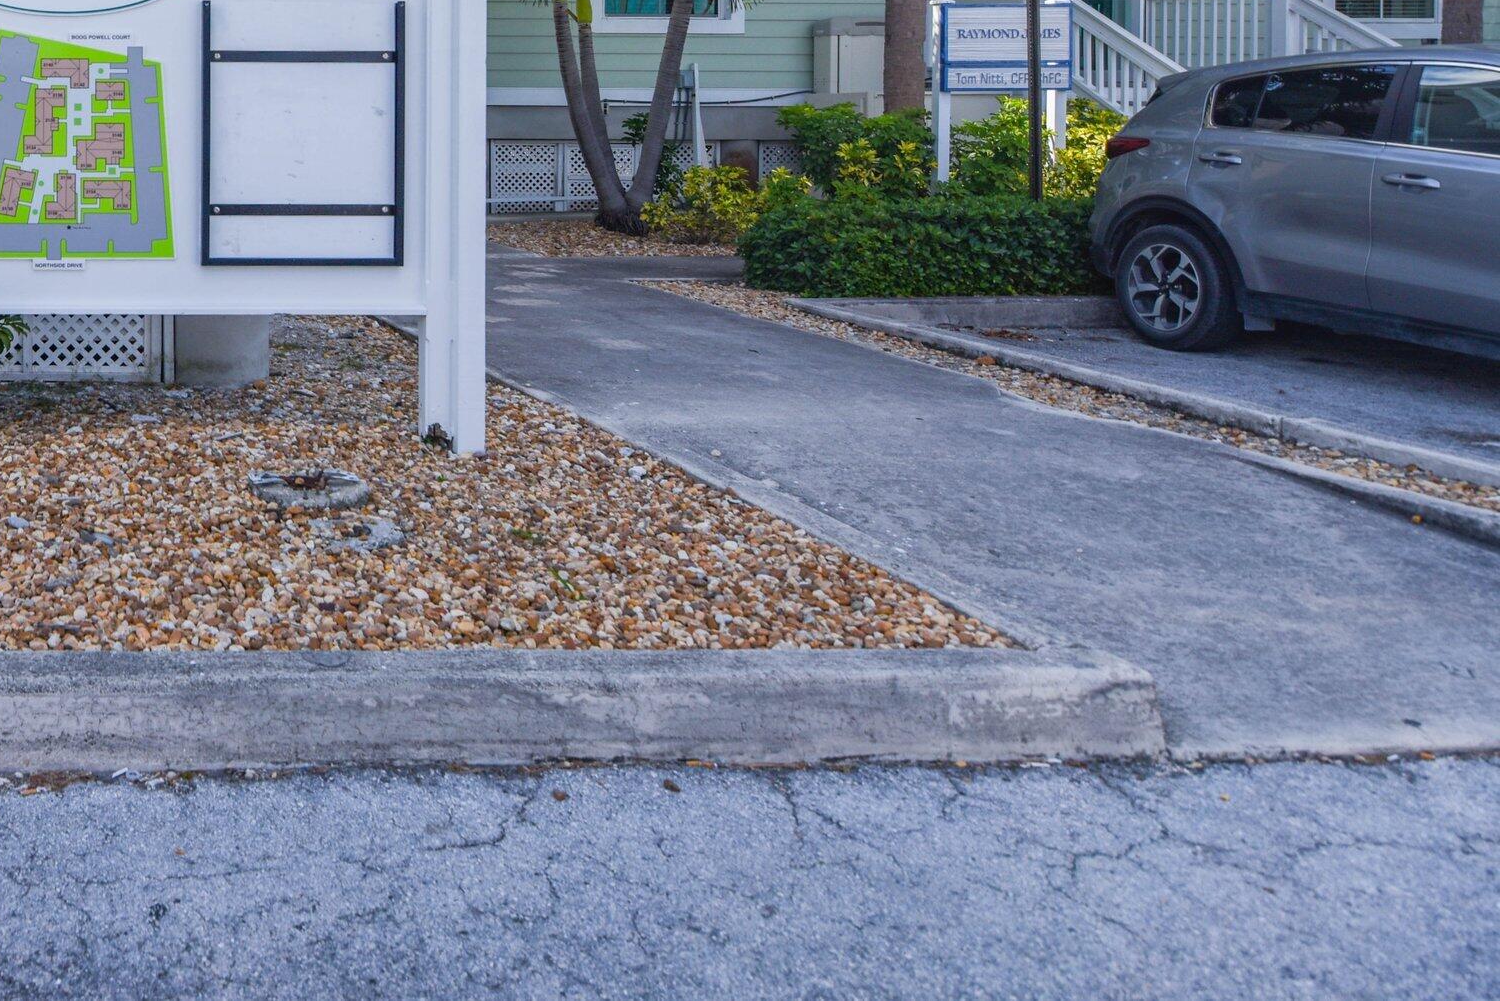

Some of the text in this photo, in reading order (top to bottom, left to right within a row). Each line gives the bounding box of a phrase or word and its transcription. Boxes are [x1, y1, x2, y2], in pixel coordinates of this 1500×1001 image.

[957, 28, 1061, 39] RAYMOND JMES
[956, 73, 977, 84] Tom
[980, 73, 1007, 86] Nitti,
[1039, 73, 1062, 85] hFC
